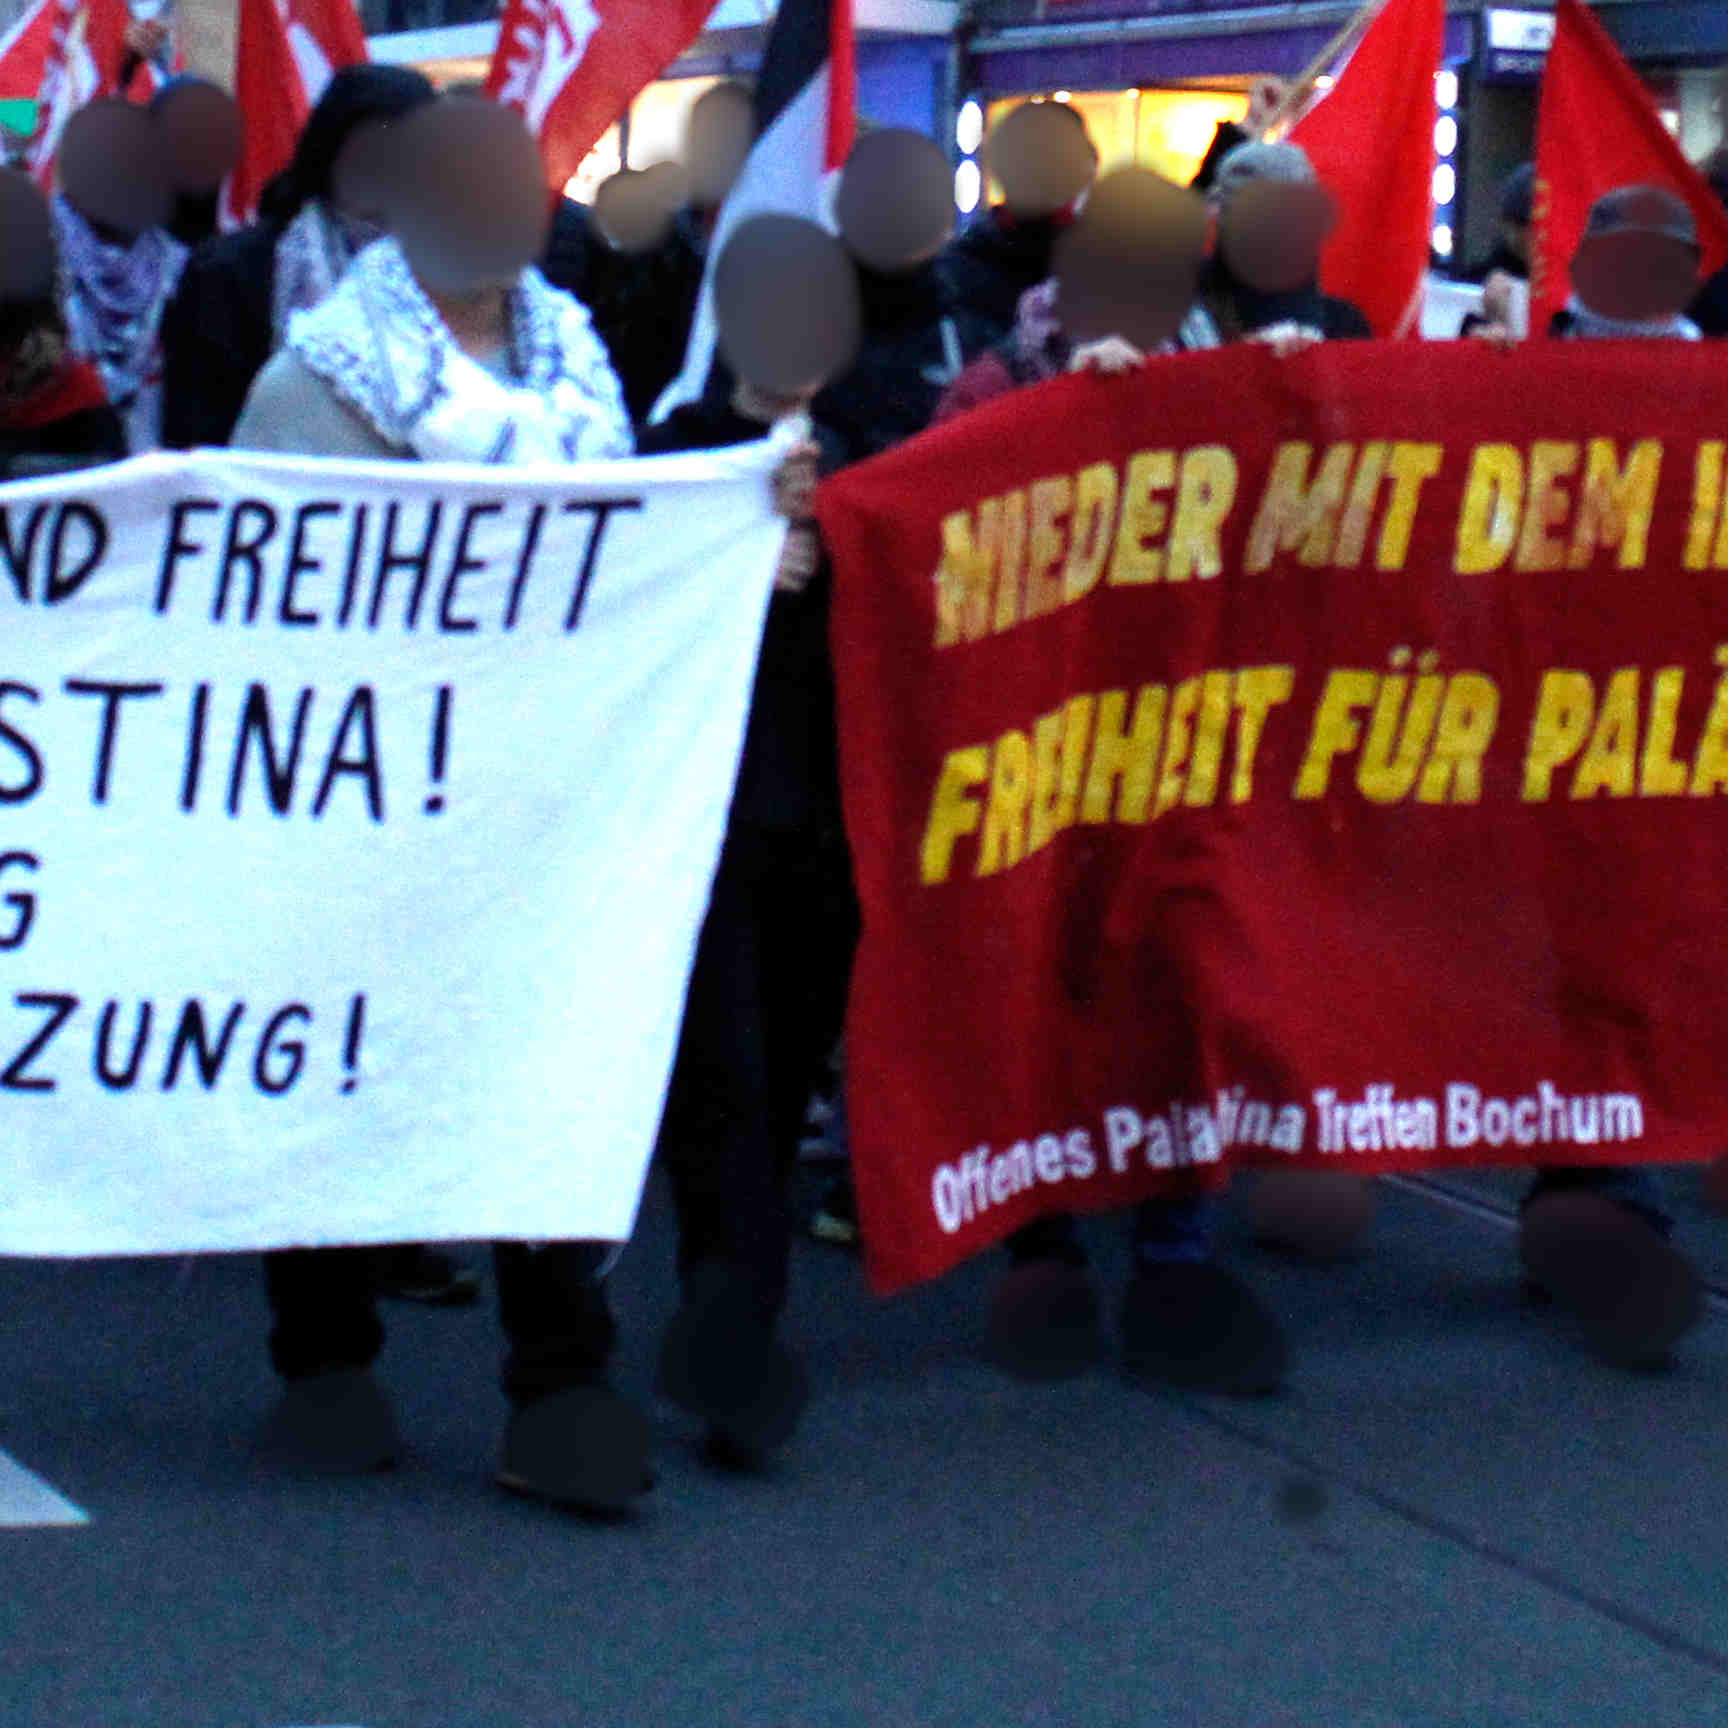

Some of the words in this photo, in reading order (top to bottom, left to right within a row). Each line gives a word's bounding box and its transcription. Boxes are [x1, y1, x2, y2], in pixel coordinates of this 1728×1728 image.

[152, 495, 643, 633] FREIHEIT
[933, 444, 1238, 650] NIEDER
[1243, 439, 1444, 574] MIT
[1453, 437, 1664, 575] DEM
[1292, 645, 1501, 805] FÜR
[931, 1126, 1097, 1234] Offenes
[1312, 1083, 1440, 1153] Treffen
[1445, 1080, 1644, 1149] Bochum
